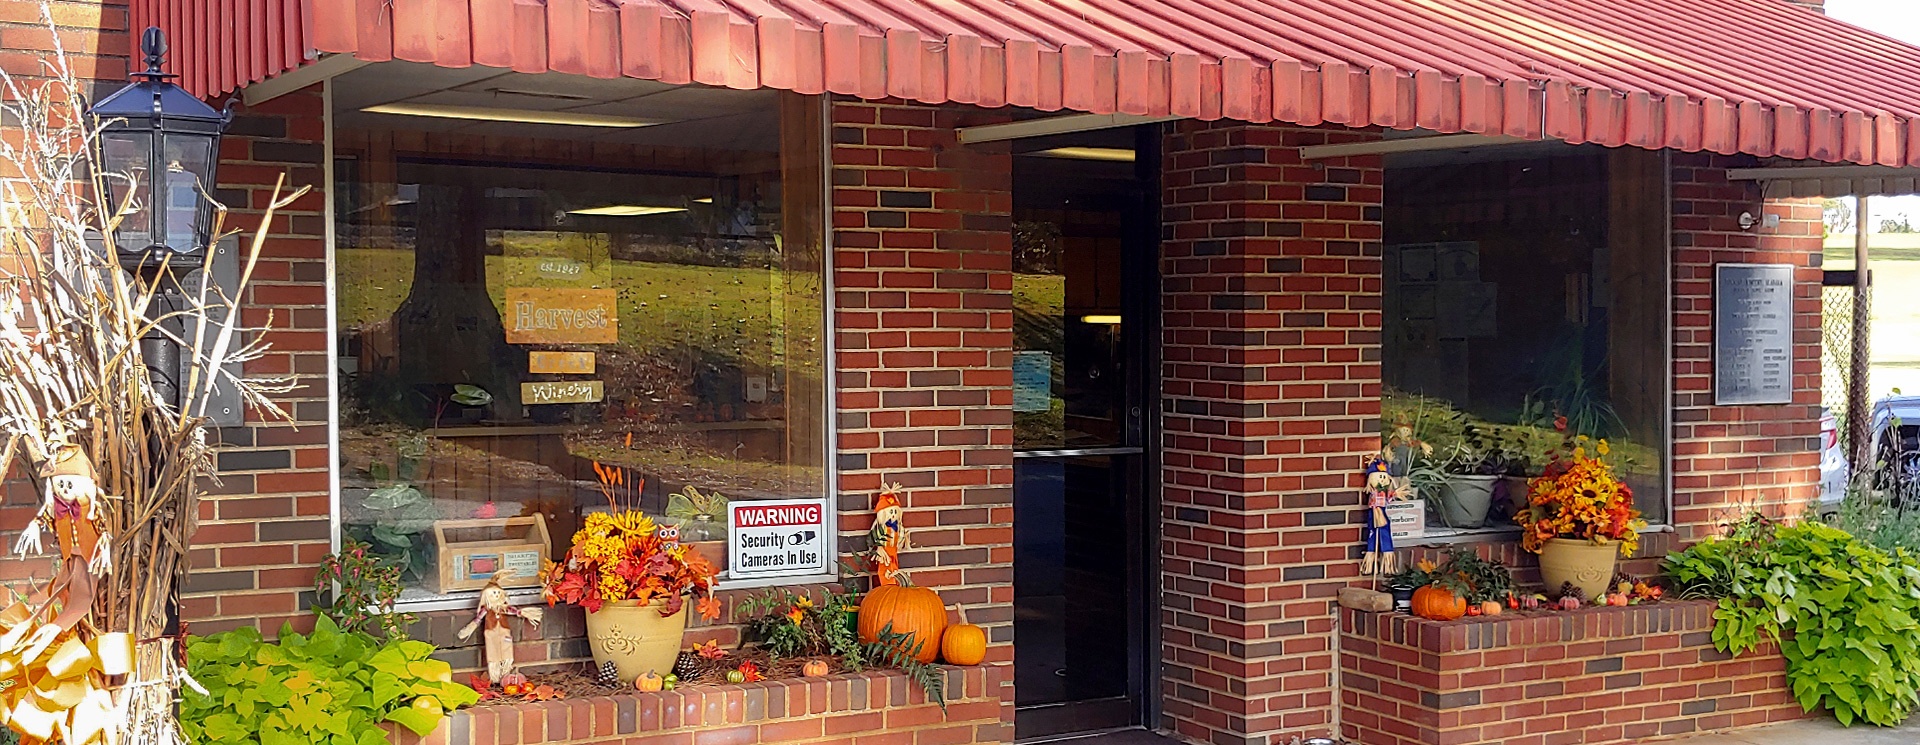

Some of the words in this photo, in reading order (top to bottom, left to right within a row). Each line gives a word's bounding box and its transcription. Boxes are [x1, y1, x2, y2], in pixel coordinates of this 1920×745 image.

[515, 301, 607, 332] Harvest
[532, 383, 593, 402] Winery
[739, 507, 818, 526] WARNING
[741, 531, 785, 549] Security
[741, 552, 784, 567] Cameras
[787, 550, 797, 565] In
[799, 549, 817, 565] Use
